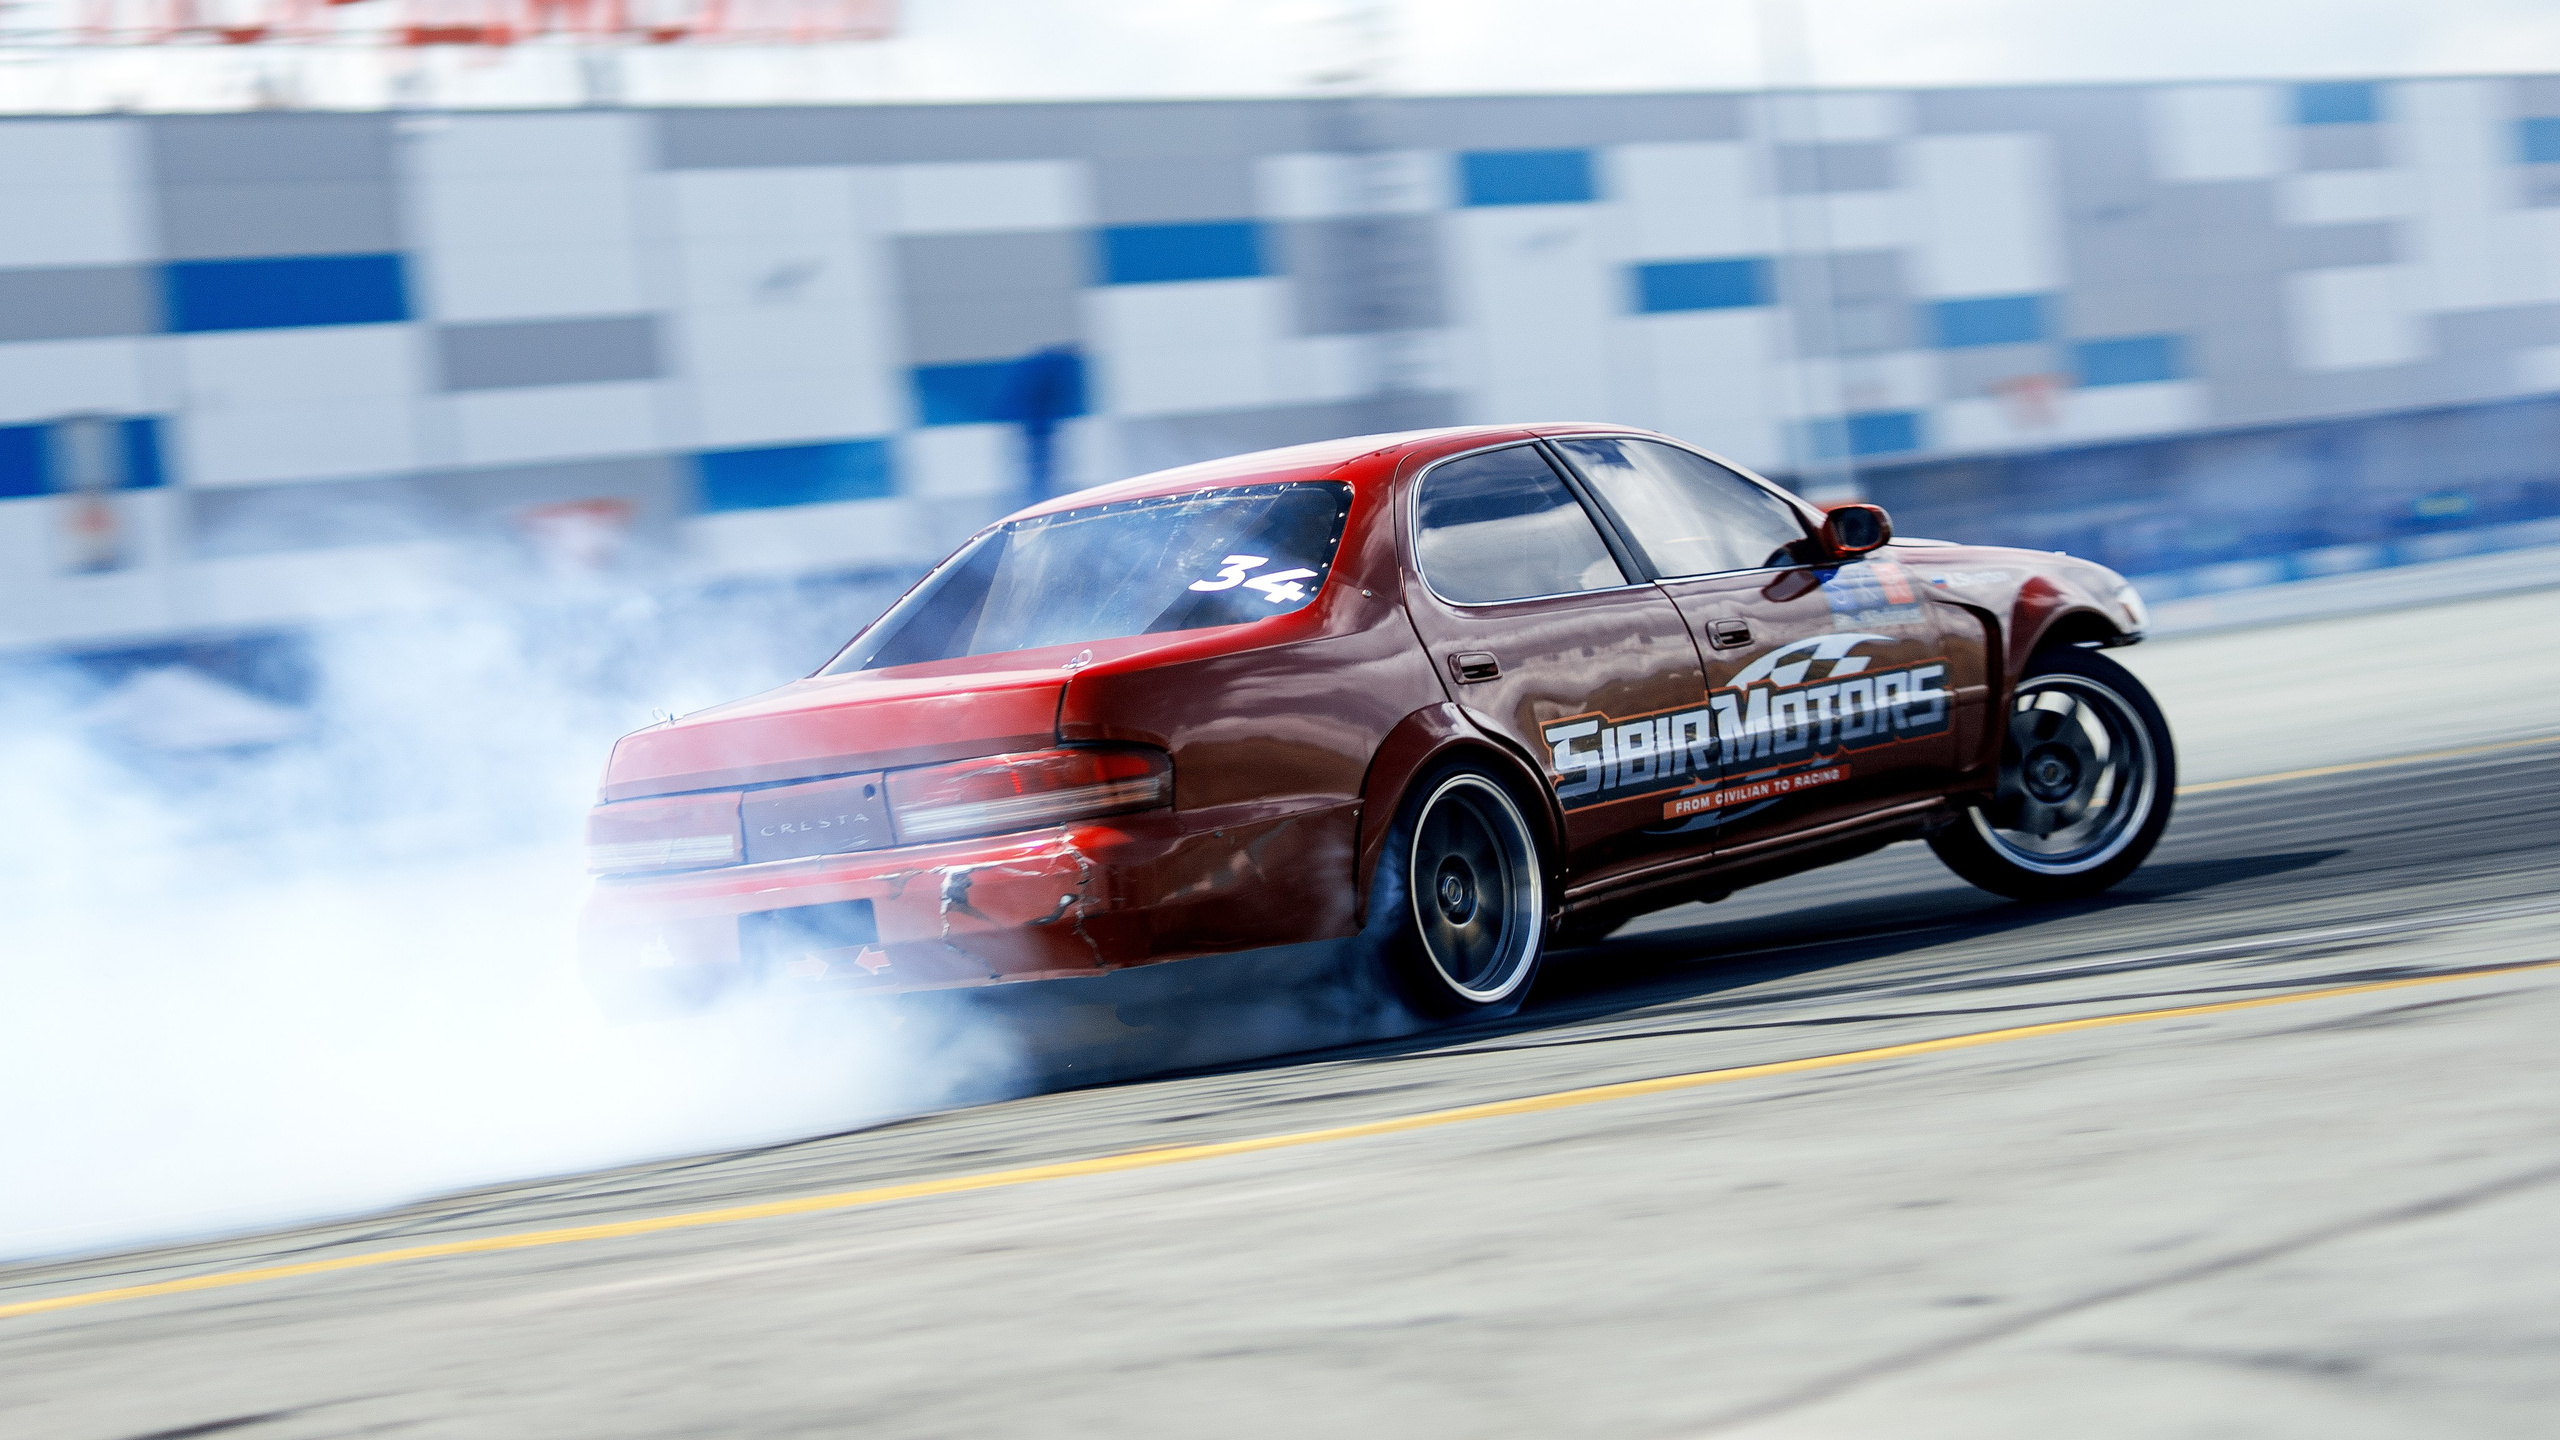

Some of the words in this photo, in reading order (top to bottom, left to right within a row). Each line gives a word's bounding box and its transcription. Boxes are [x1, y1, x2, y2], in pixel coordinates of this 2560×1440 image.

[1188, 554, 1318, 603] 34
[1545, 709, 1710, 798] SIBIR
[1710, 665, 1946, 765] MOTORS
[1675, 797, 1710, 813] FROM
[1715, 784, 1769, 805] CIVILIAN
[1774, 779, 1790, 792] TO
[1794, 769, 1840, 787] RACING
[760, 813, 870, 837] CRESTA
